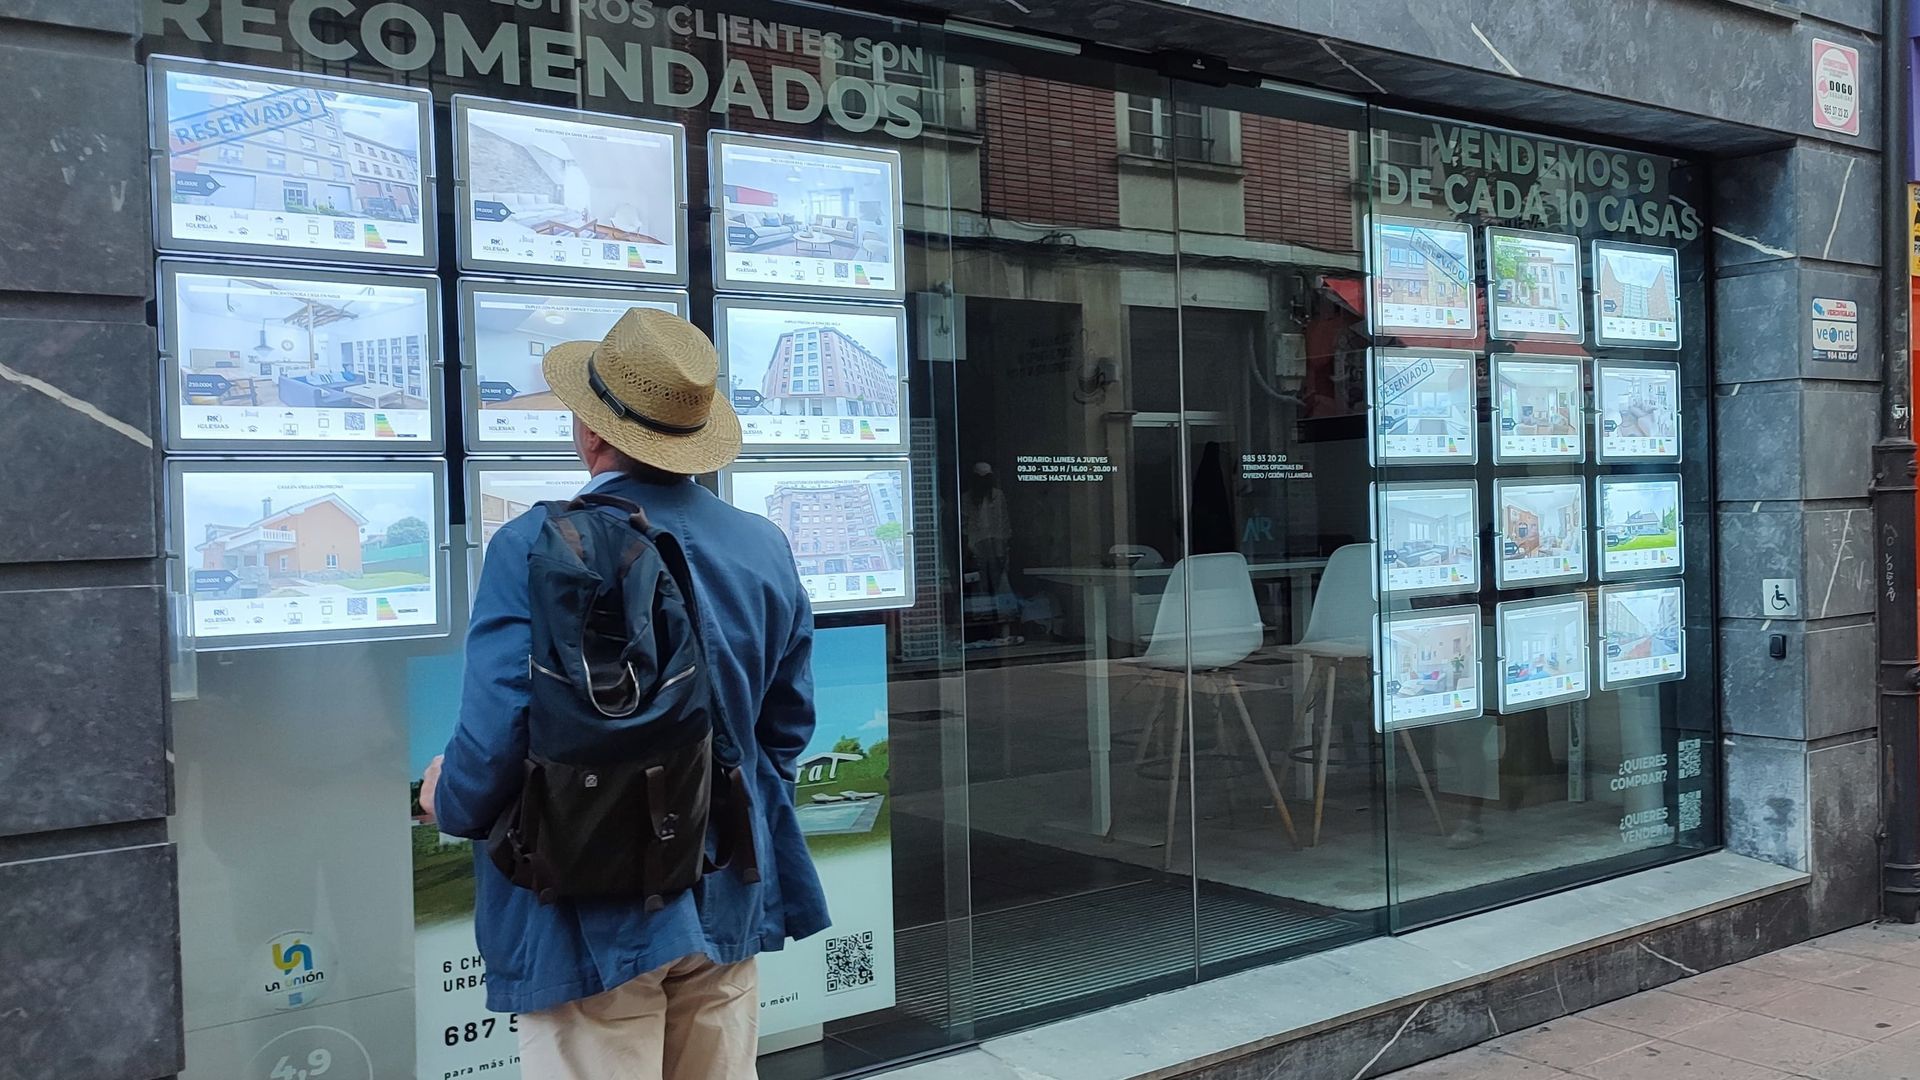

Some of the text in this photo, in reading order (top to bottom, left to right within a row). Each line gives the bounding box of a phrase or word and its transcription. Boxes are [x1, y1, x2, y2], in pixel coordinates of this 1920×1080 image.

[667, 5, 844, 60] CLIENTES
[854, 37, 923, 73] SON
[142, 0, 922, 139] RECOMENDADOS
[1829, 80, 1852, 95] DOGO
[176, 95, 312, 146] RESERVADO
[1432, 123, 1655, 193] VENDEMOS 9
[1380, 163, 1698, 240] DE CADA 10 CASAS
[1242, 454, 1287, 462] 985 93 20 20
[1618, 754, 1668, 775] ¿QUIERES
[1610, 770, 1668, 791] COMPRAR?
[1619, 807, 1668, 830] ¿QUIERES
[1620, 823, 1669, 844] VENDER?
[443, 955, 482, 973] 6 CH
[443, 973, 487, 992] URBA
[770, 992, 798, 1006] móvil
[444, 1013, 519, 1047] 687 5
[270, 1048, 331, 1080] 4,9
[444, 1056, 521, 1080] para más in
